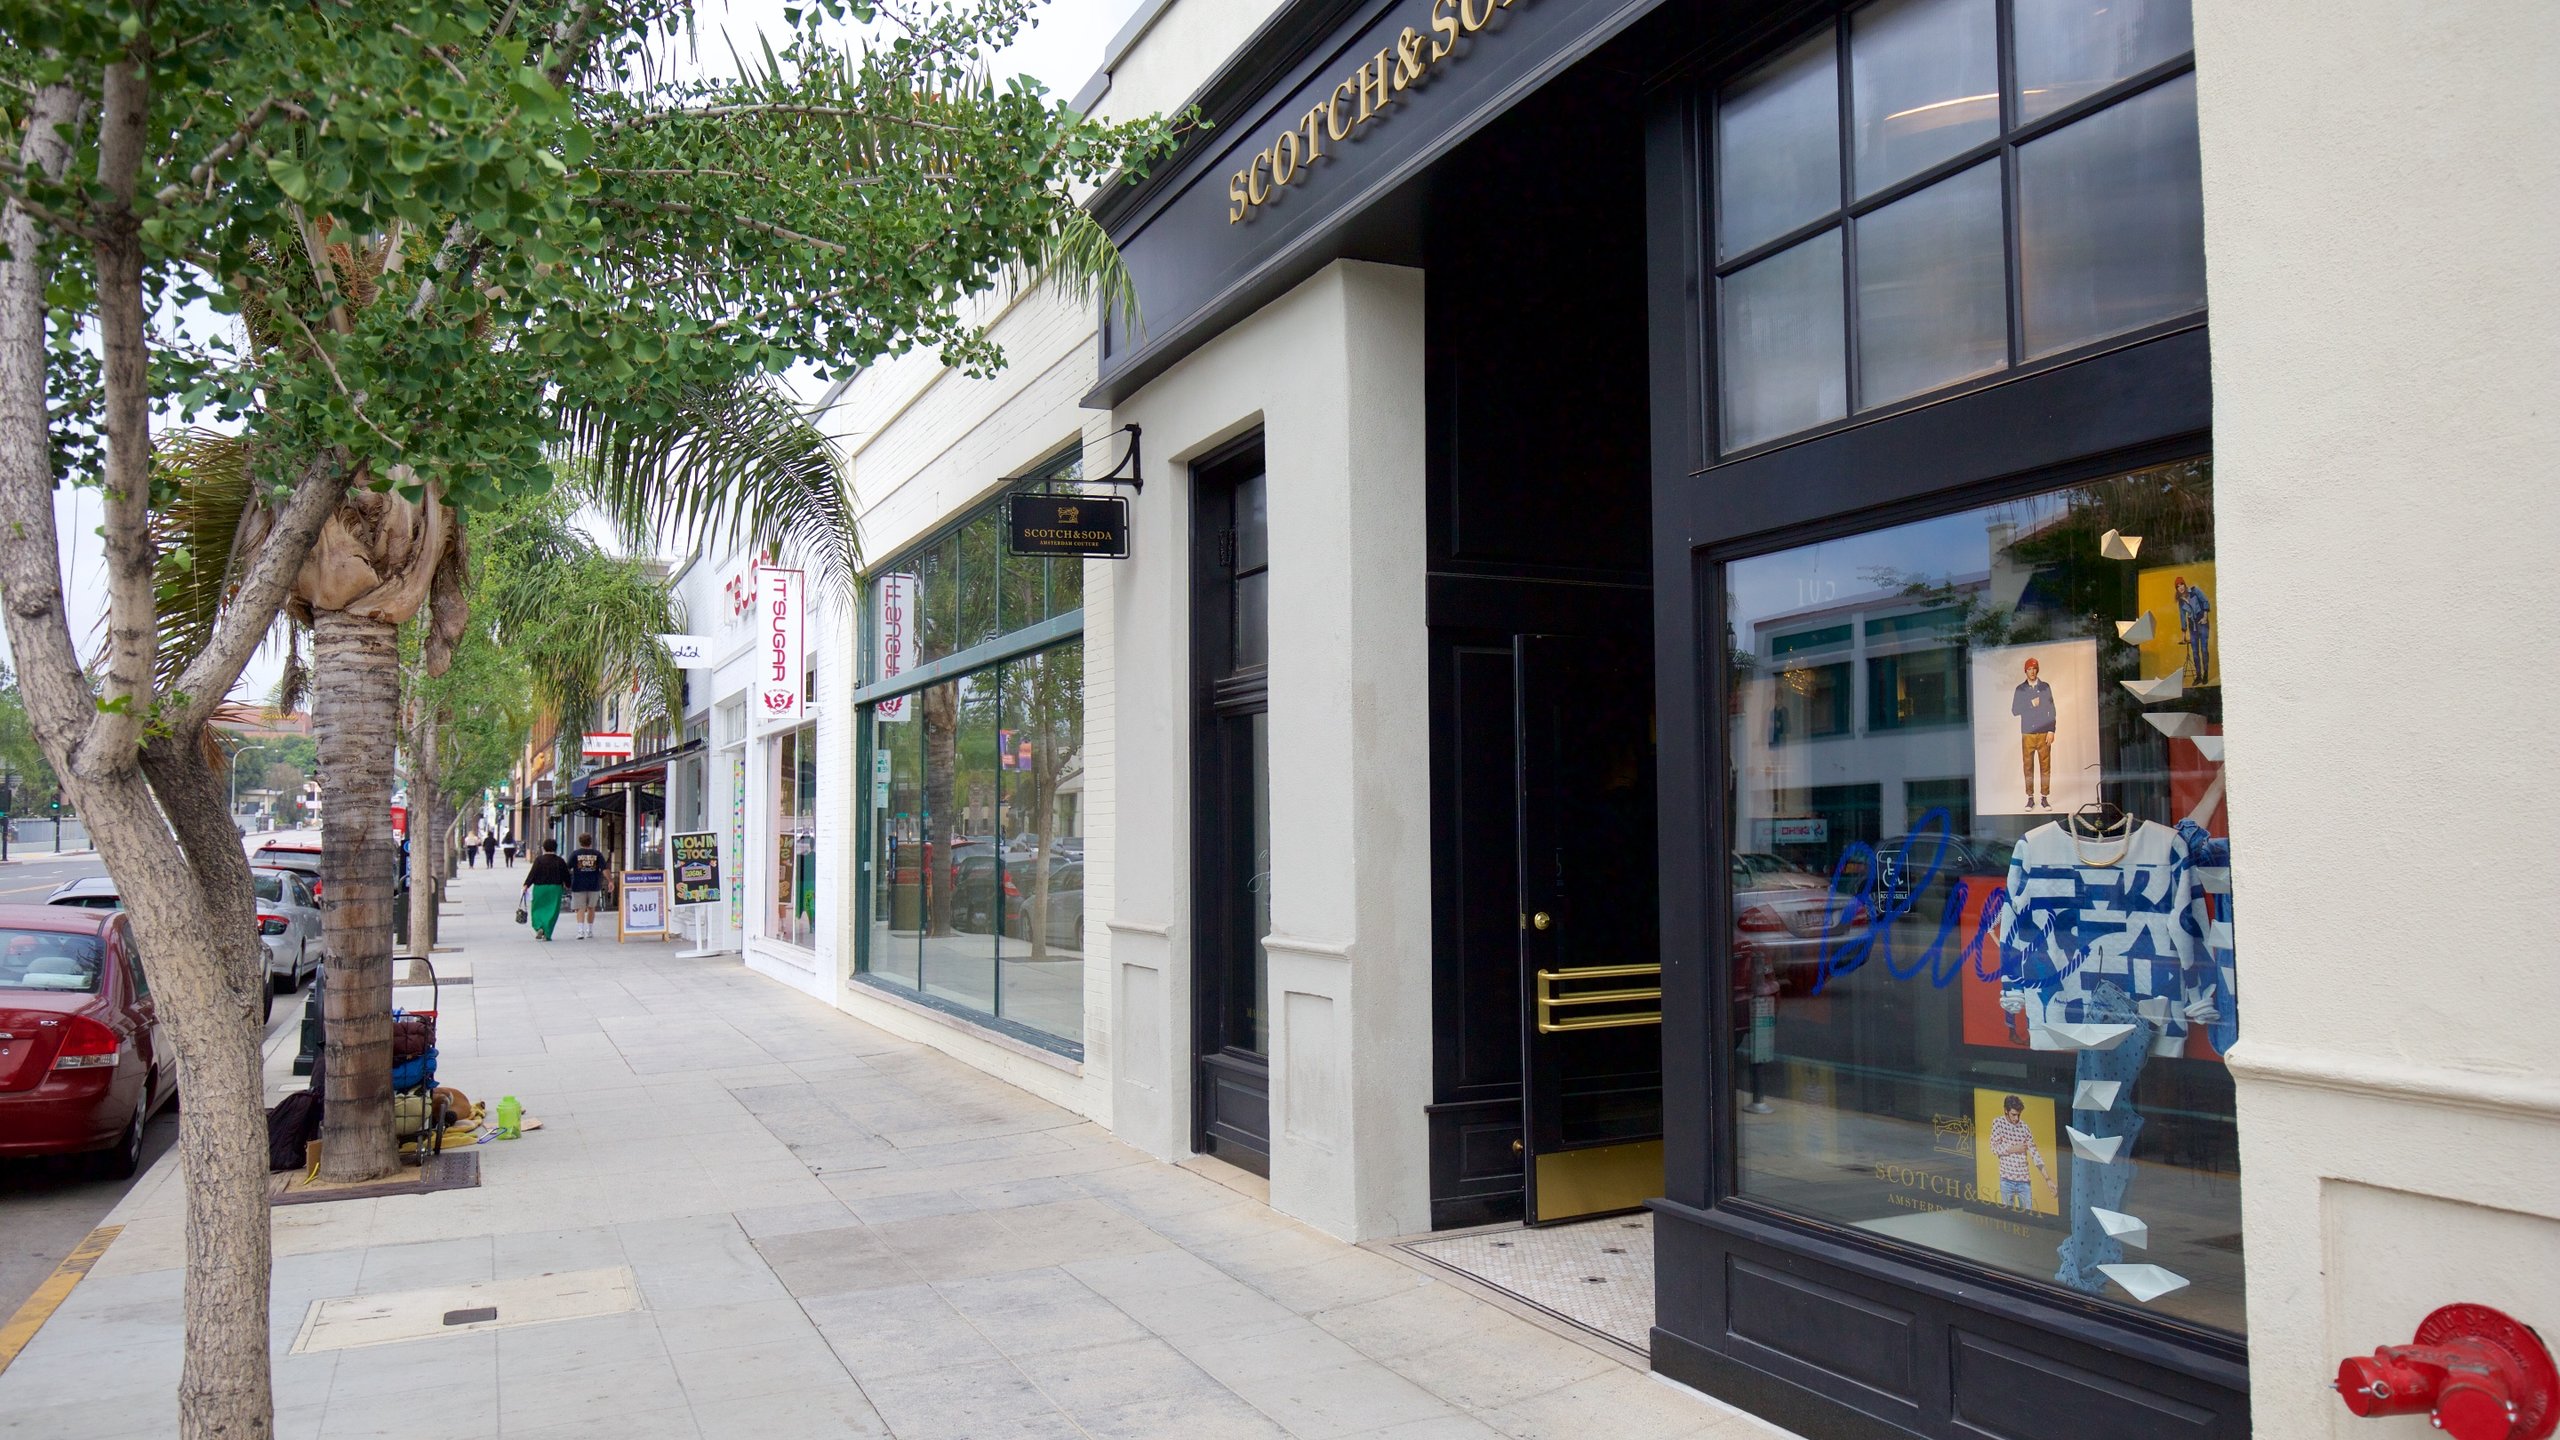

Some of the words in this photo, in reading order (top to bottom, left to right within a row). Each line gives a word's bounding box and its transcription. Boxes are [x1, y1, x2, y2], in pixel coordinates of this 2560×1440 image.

[1229, 0, 1513, 225] SCOTCH&SO
[1024, 528, 1112, 540] SCOTCH&SODA
[772, 578, 787, 682] IT'SUGAR
[632, 903, 657, 912] SALE!
[1875, 1162, 2043, 1219] SCOTCH&SODA
